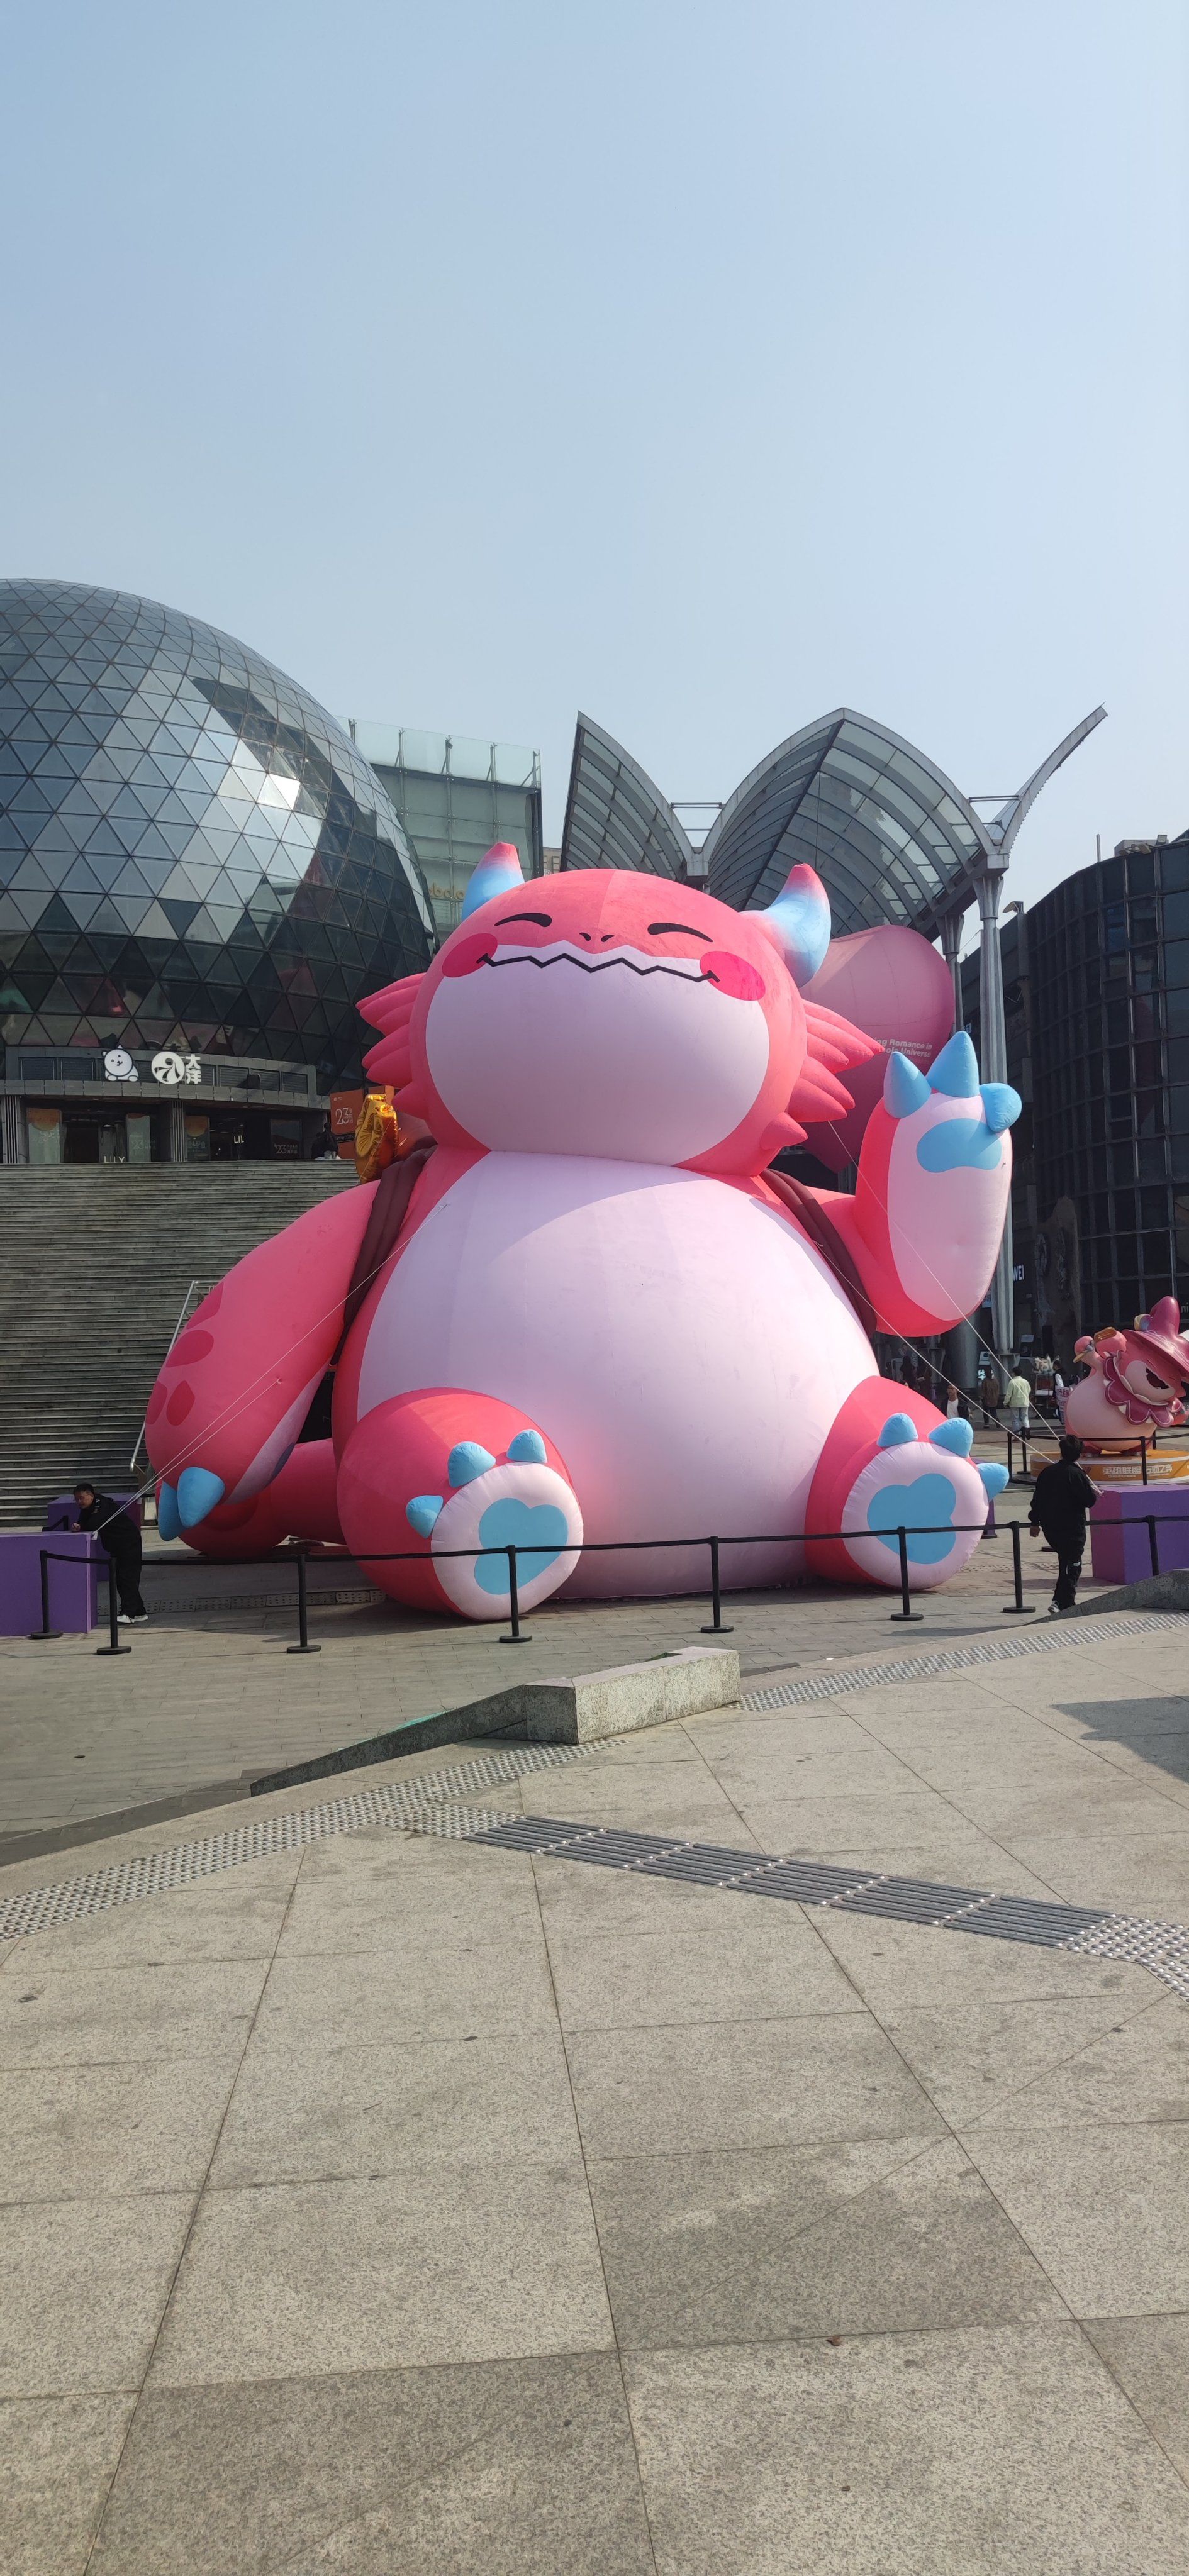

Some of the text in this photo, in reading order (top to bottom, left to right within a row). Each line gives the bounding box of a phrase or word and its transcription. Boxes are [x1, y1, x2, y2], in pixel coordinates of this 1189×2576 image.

[889, 1039, 925, 1049] Romance
[901, 1047, 931, 1057] Universe
[185, 1054, 201, 1084] 大洋
[1102, 1466, 1142, 1475] 英雄联盟
